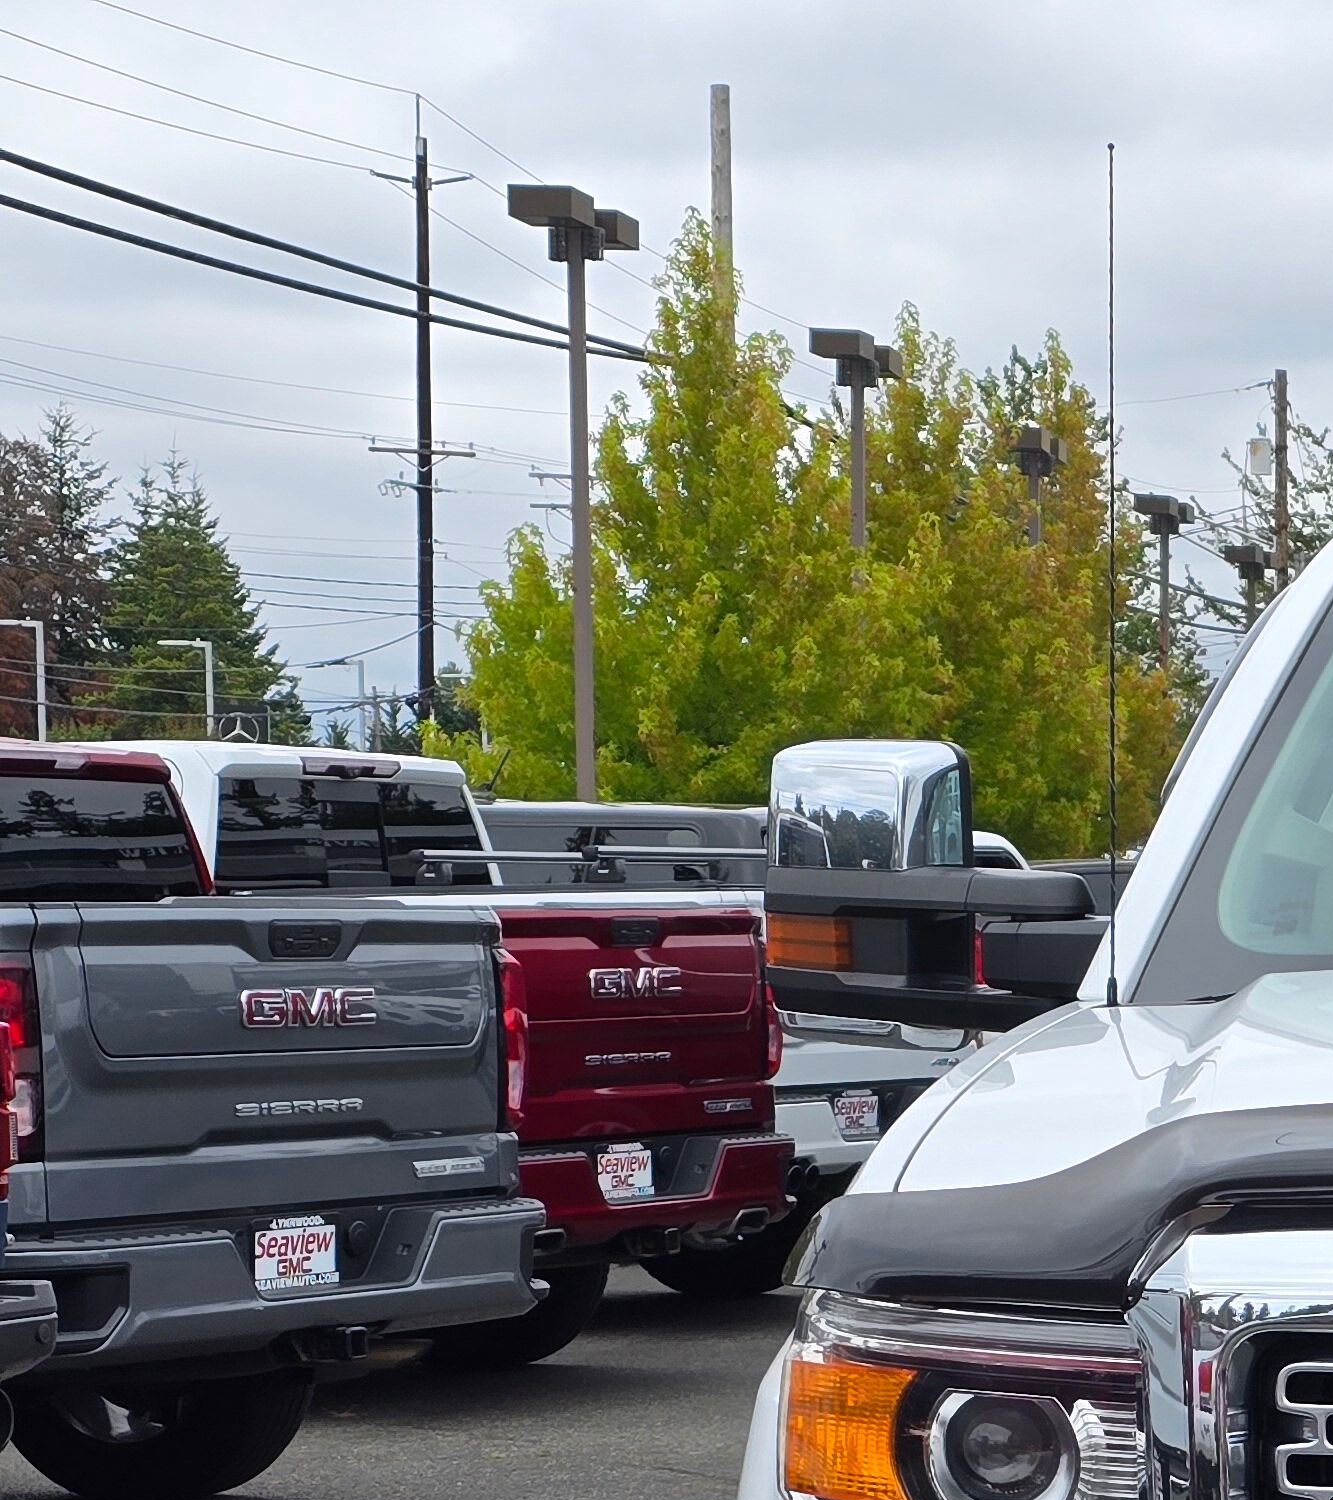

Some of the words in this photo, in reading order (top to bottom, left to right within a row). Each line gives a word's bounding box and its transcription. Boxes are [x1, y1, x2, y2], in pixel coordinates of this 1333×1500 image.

[588, 967, 683, 998] GMC
[240, 987, 377, 1028] GMC
[234, 1097, 364, 1117] SIERRA
[597, 1152, 650, 1175] Seaview
[611, 1174, 636, 1189] GMC
[255, 1228, 334, 1259] Seaview
[276, 1255, 313, 1276] GMC
